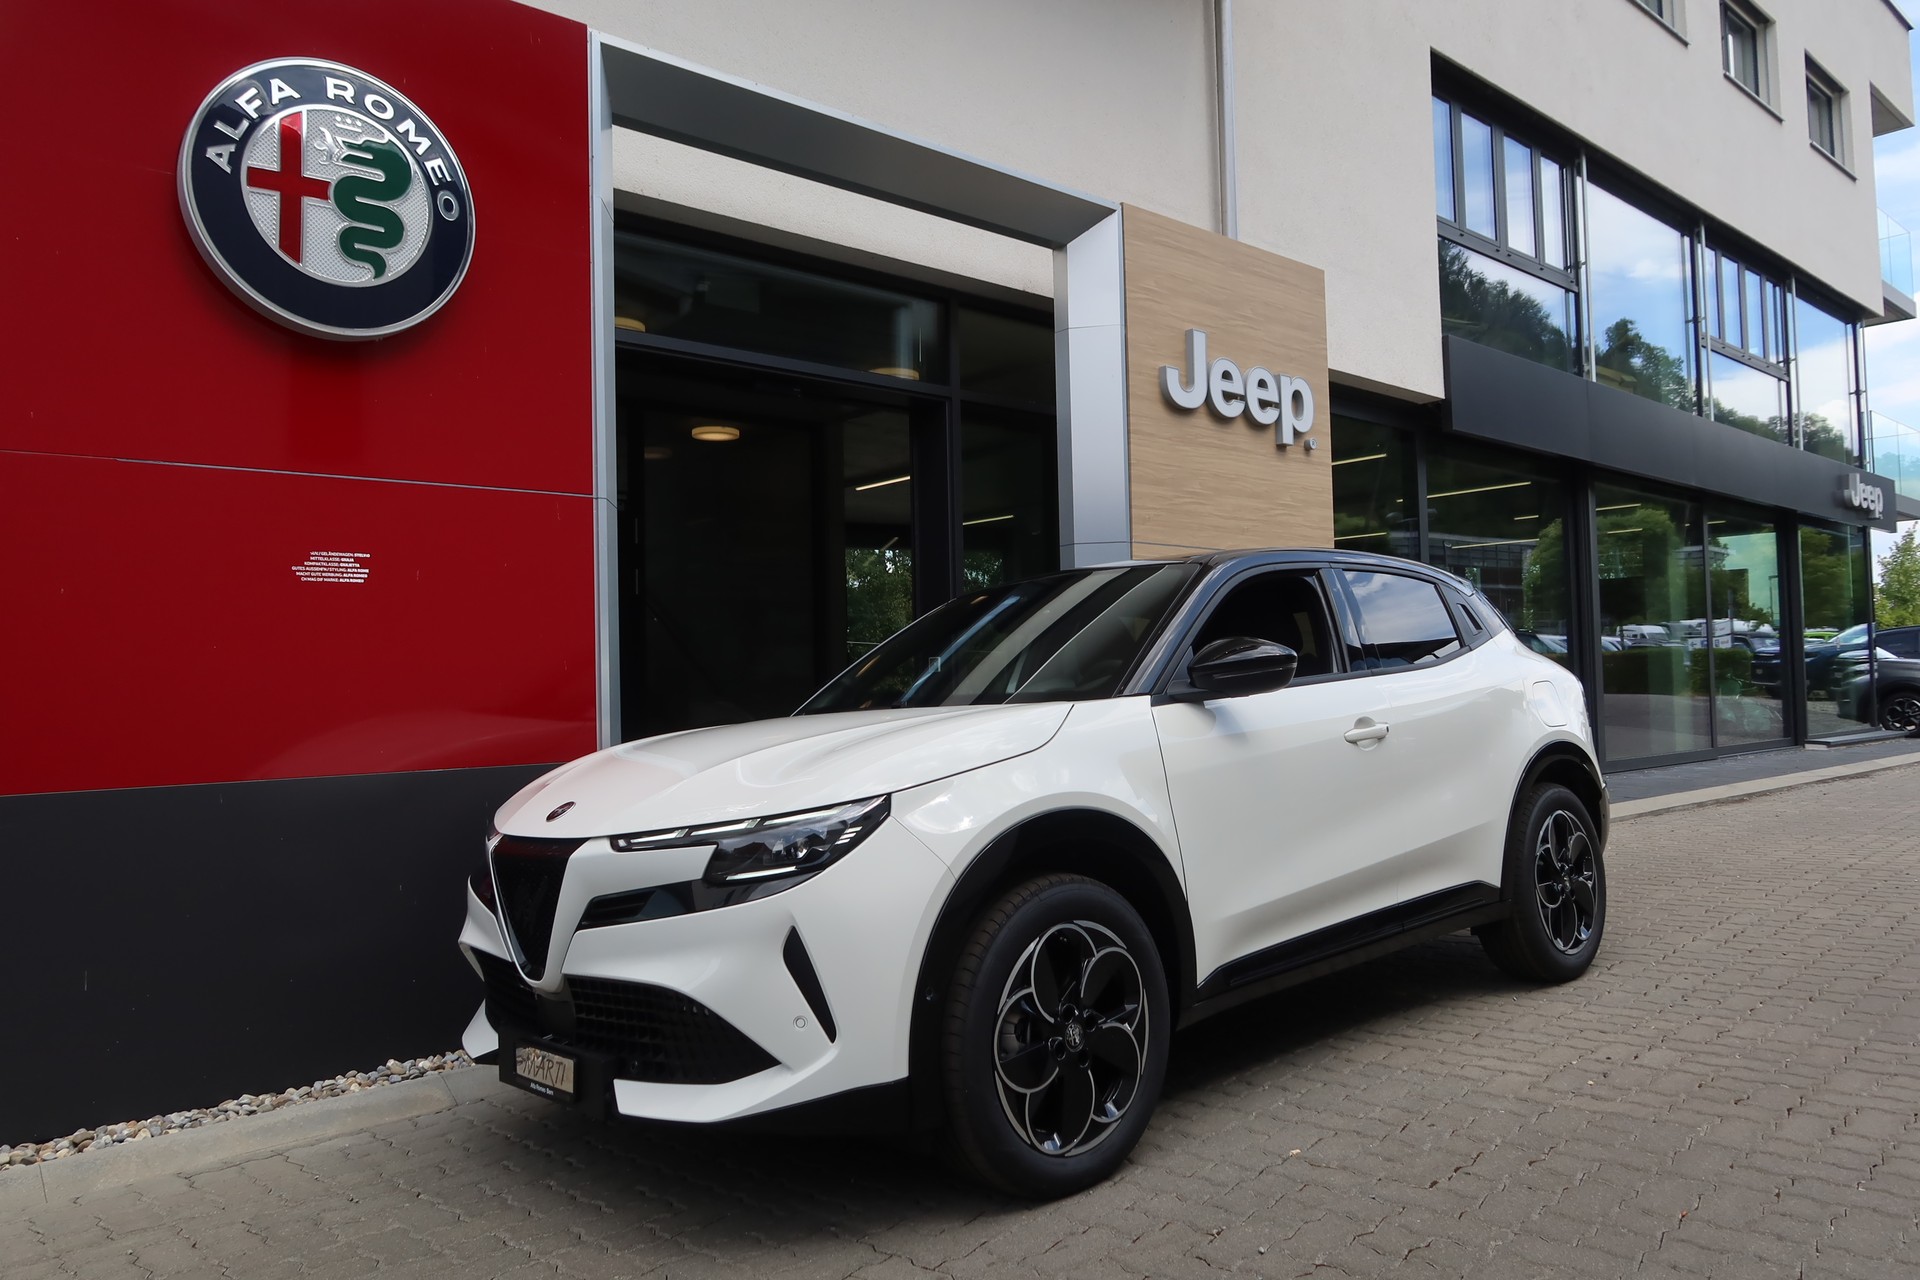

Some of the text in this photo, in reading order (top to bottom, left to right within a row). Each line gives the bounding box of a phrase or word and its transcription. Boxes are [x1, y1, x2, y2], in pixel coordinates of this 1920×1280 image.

[206, 77, 460, 221] ALFA ROMEO
[1159, 327, 1315, 447] Jeep
[1843, 472, 1884, 519] Jeep
